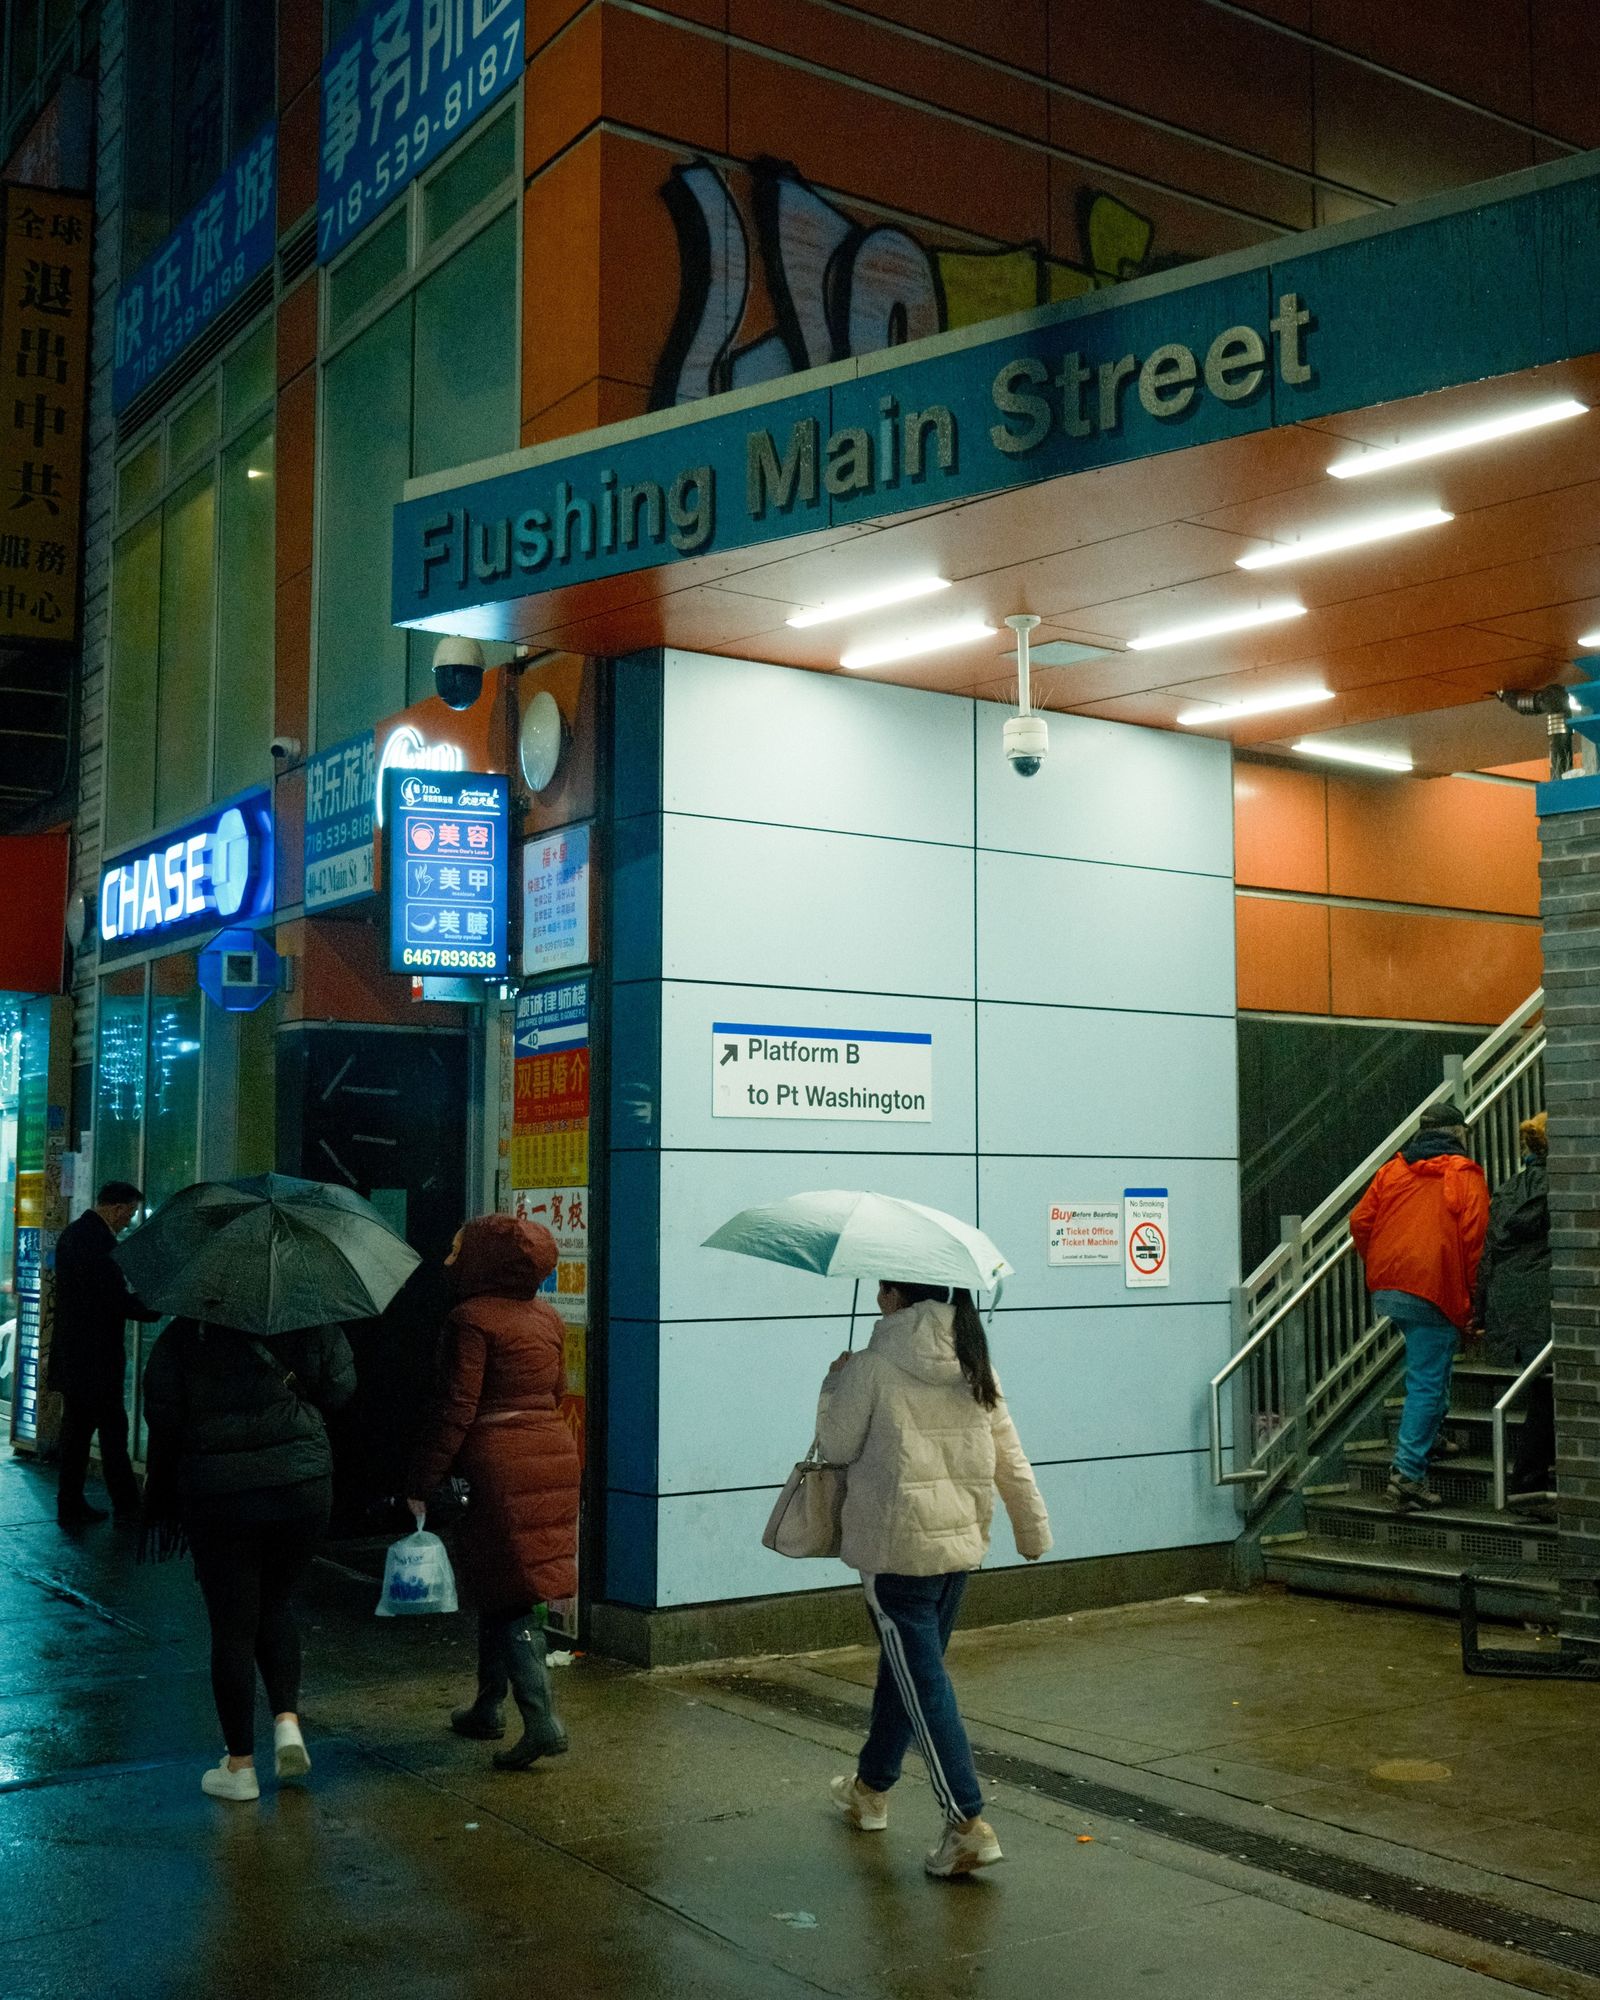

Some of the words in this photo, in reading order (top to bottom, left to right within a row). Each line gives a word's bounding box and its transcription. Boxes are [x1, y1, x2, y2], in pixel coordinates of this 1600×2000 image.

[321, 18, 521, 252] 718-539-8187
[114, 134, 275, 369] 快乐旅游
[133, 251, 246, 390] 718-539-8188
[421, 465, 714, 594] Flushing
[747, 395, 954, 516] Main
[991, 293, 1311, 454] Street
[306, 815, 374, 856] 718-539-818
[438, 823, 489, 849] 美容
[102, 833, 207, 940] CHASE
[329, 863, 348, 891] Main
[439, 866, 489, 892] 美甲
[438, 910, 489, 935] 美睫
[403, 948, 496, 968] 6467893638
[528, 1033, 538, 1046] 4D
[748, 1038, 839, 1064] Platform
[846, 1043, 860, 1065] B
[747, 1084, 769, 1105] to
[777, 1084, 799, 1106] Pt
[805, 1085, 925, 1114] Washington
[1051, 1208, 1073, 1223] Buy
[1073, 1211, 1091, 1219] Before
[1139, 1200, 1165, 1209] Smoking
[1142, 1211, 1162, 1219] Vaping
[1056, 1228, 1064, 1236] at
[1066, 1228, 1089, 1236] Ticket
[1091, 1227, 1114, 1236] Office
[1062, 1238, 1085, 1247] Ticket
[1087, 1238, 1119, 1246] Machine
